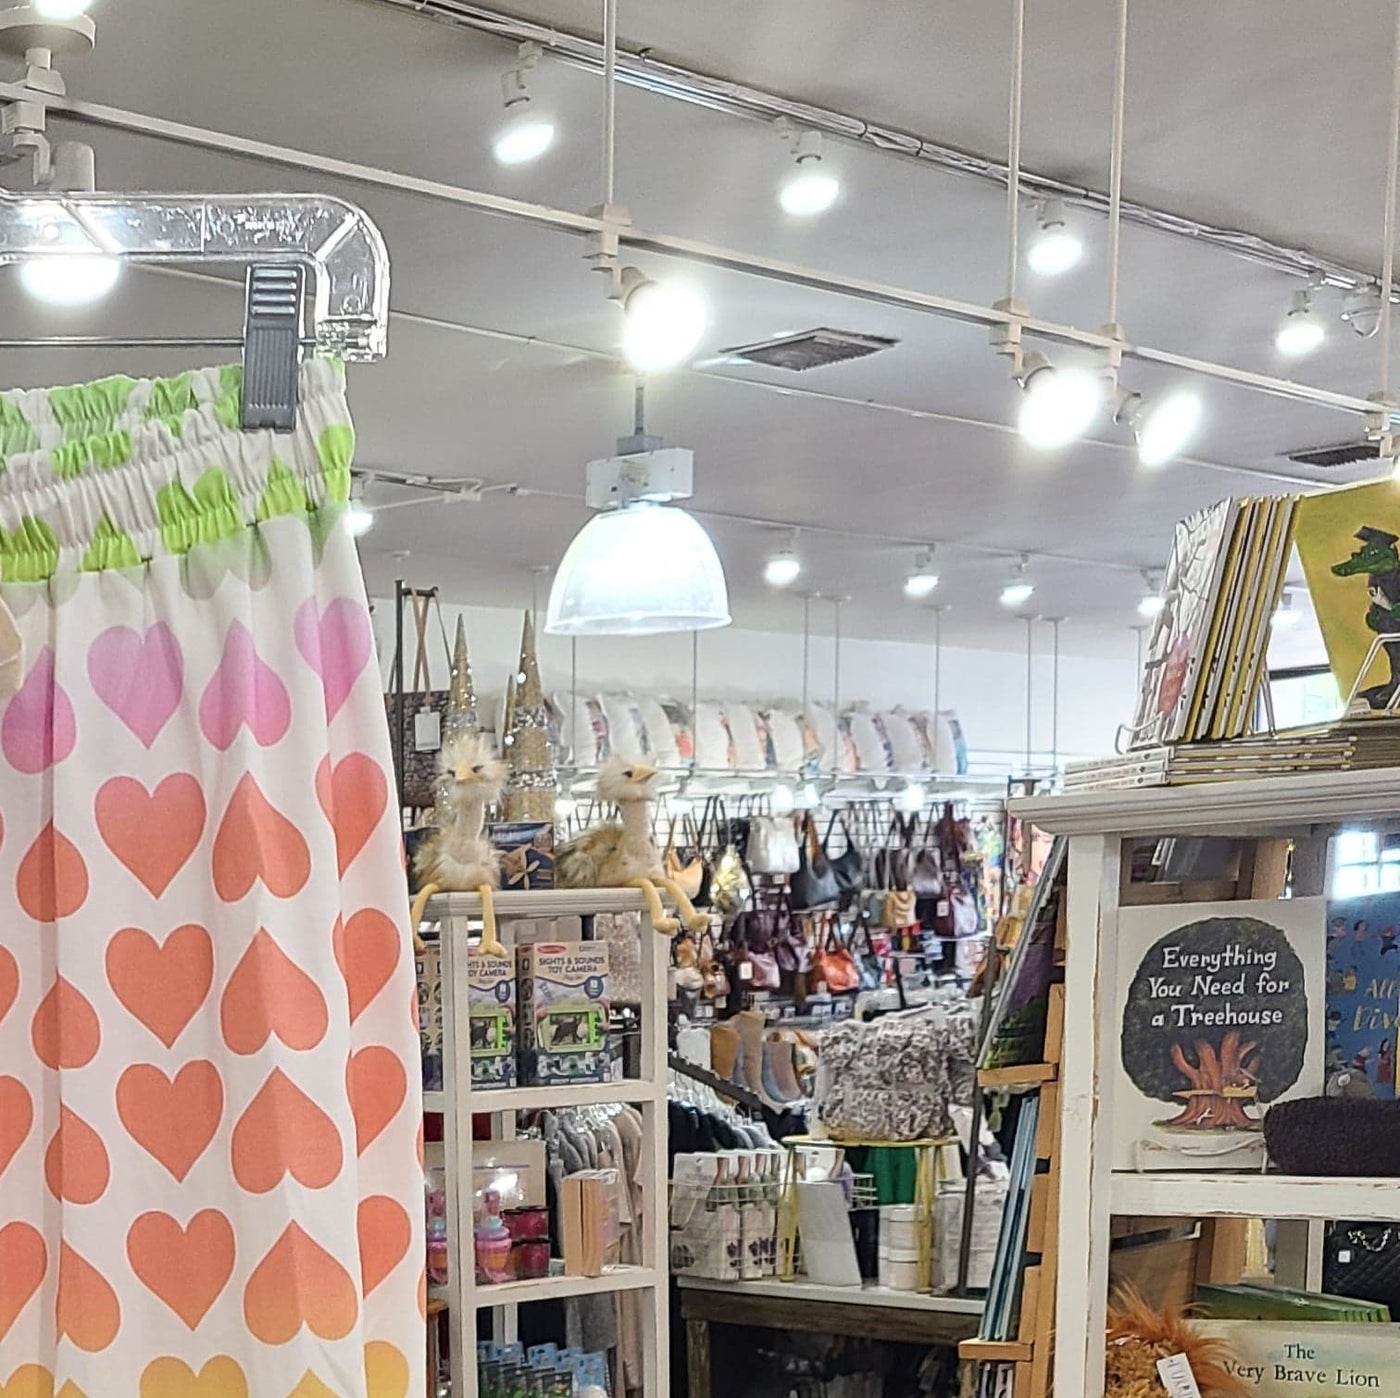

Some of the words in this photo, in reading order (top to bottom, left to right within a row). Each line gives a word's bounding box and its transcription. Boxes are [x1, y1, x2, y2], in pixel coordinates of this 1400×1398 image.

[539, 957, 565, 966] SIGHTS
[574, 956, 606, 965] SOUNDS
[548, 966, 563, 974] TOY
[565, 965, 598, 973] CAMERA
[1163, 944, 1277, 973] Everything
[1148, 976, 1182, 998] You
[1191, 973, 1245, 995] Need
[1255, 972, 1290, 994] for
[1151, 1013, 1165, 1027] a
[1171, 1002, 1283, 1027] Treehouse
[1284, 1344, 1315, 1360] The
[1223, 1361, 1264, 1384] Very
[1274, 1365, 1327, 1383] Brave
[1336, 1369, 1380, 1388] Lion
